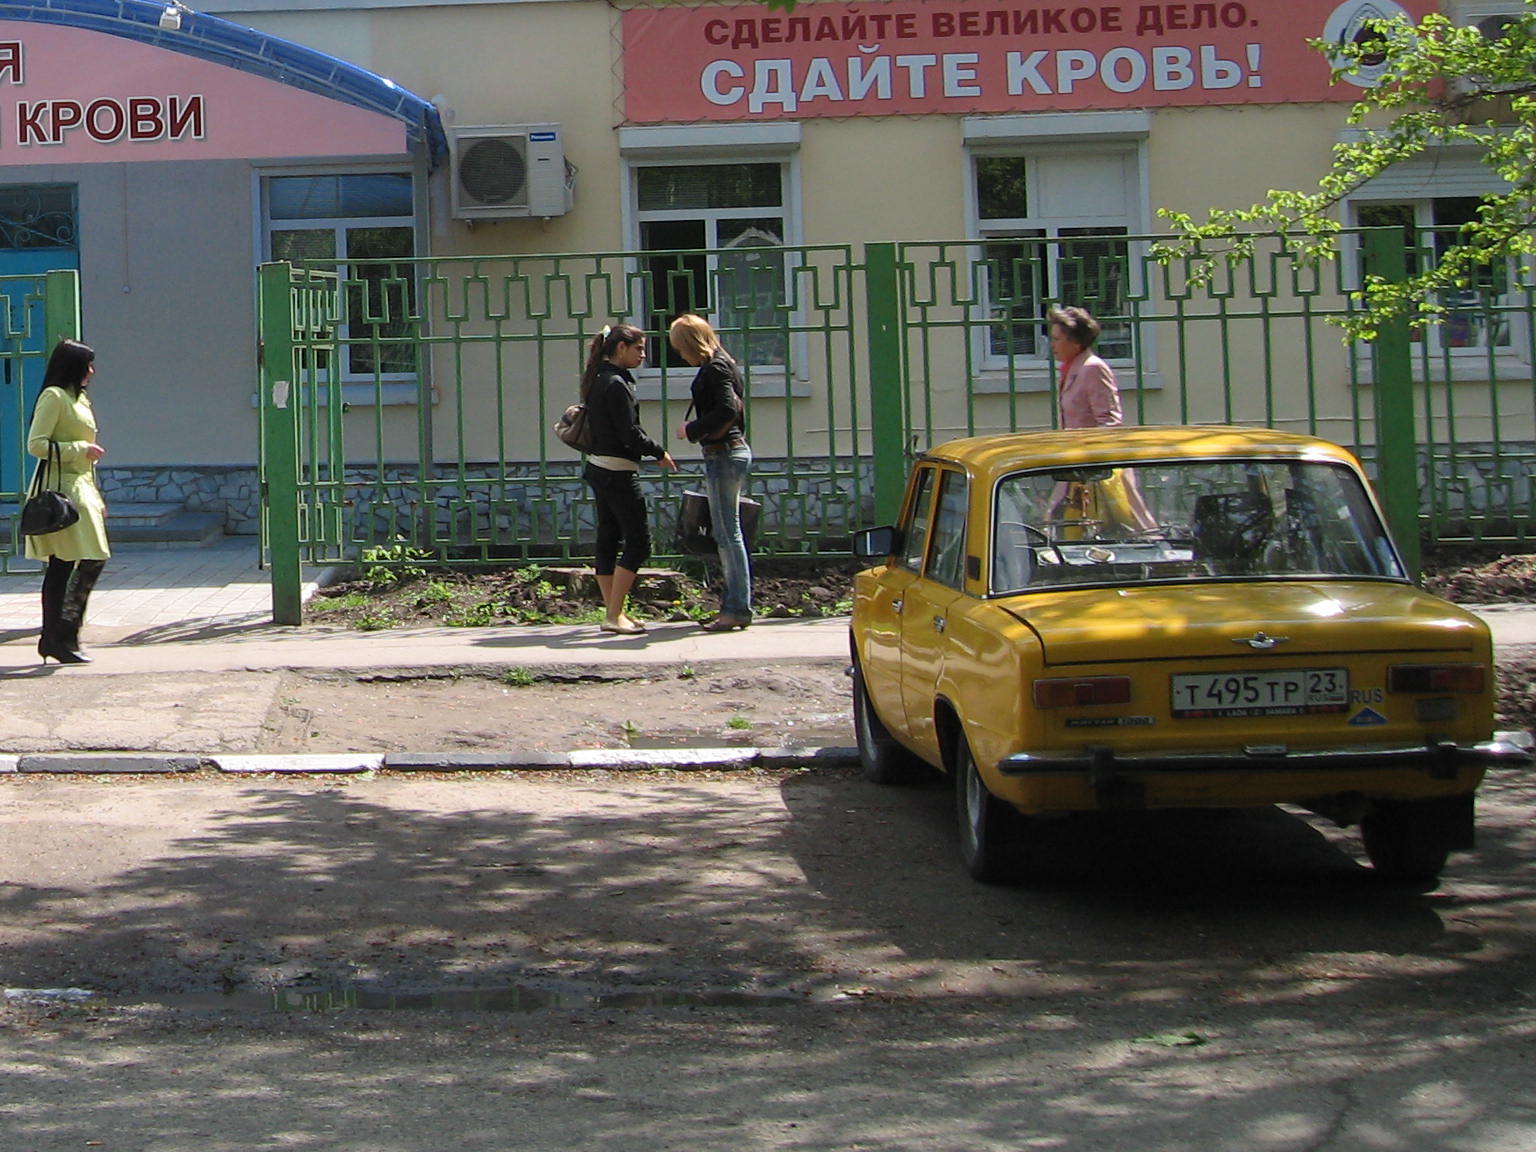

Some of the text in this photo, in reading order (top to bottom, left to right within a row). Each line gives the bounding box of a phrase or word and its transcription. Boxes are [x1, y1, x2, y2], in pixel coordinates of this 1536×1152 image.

[703, 1, 1260, 50] СДЕЛАЙТЕ ВЕЛИКОЕ ДЕЛО.
[699, 42, 1263, 114] СДАЙТЕ КРОВЬ!
[16, 94, 205, 146] КРОВИ
[1309, 672, 1337, 694] 23
[1350, 688, 1383, 704] RUS
